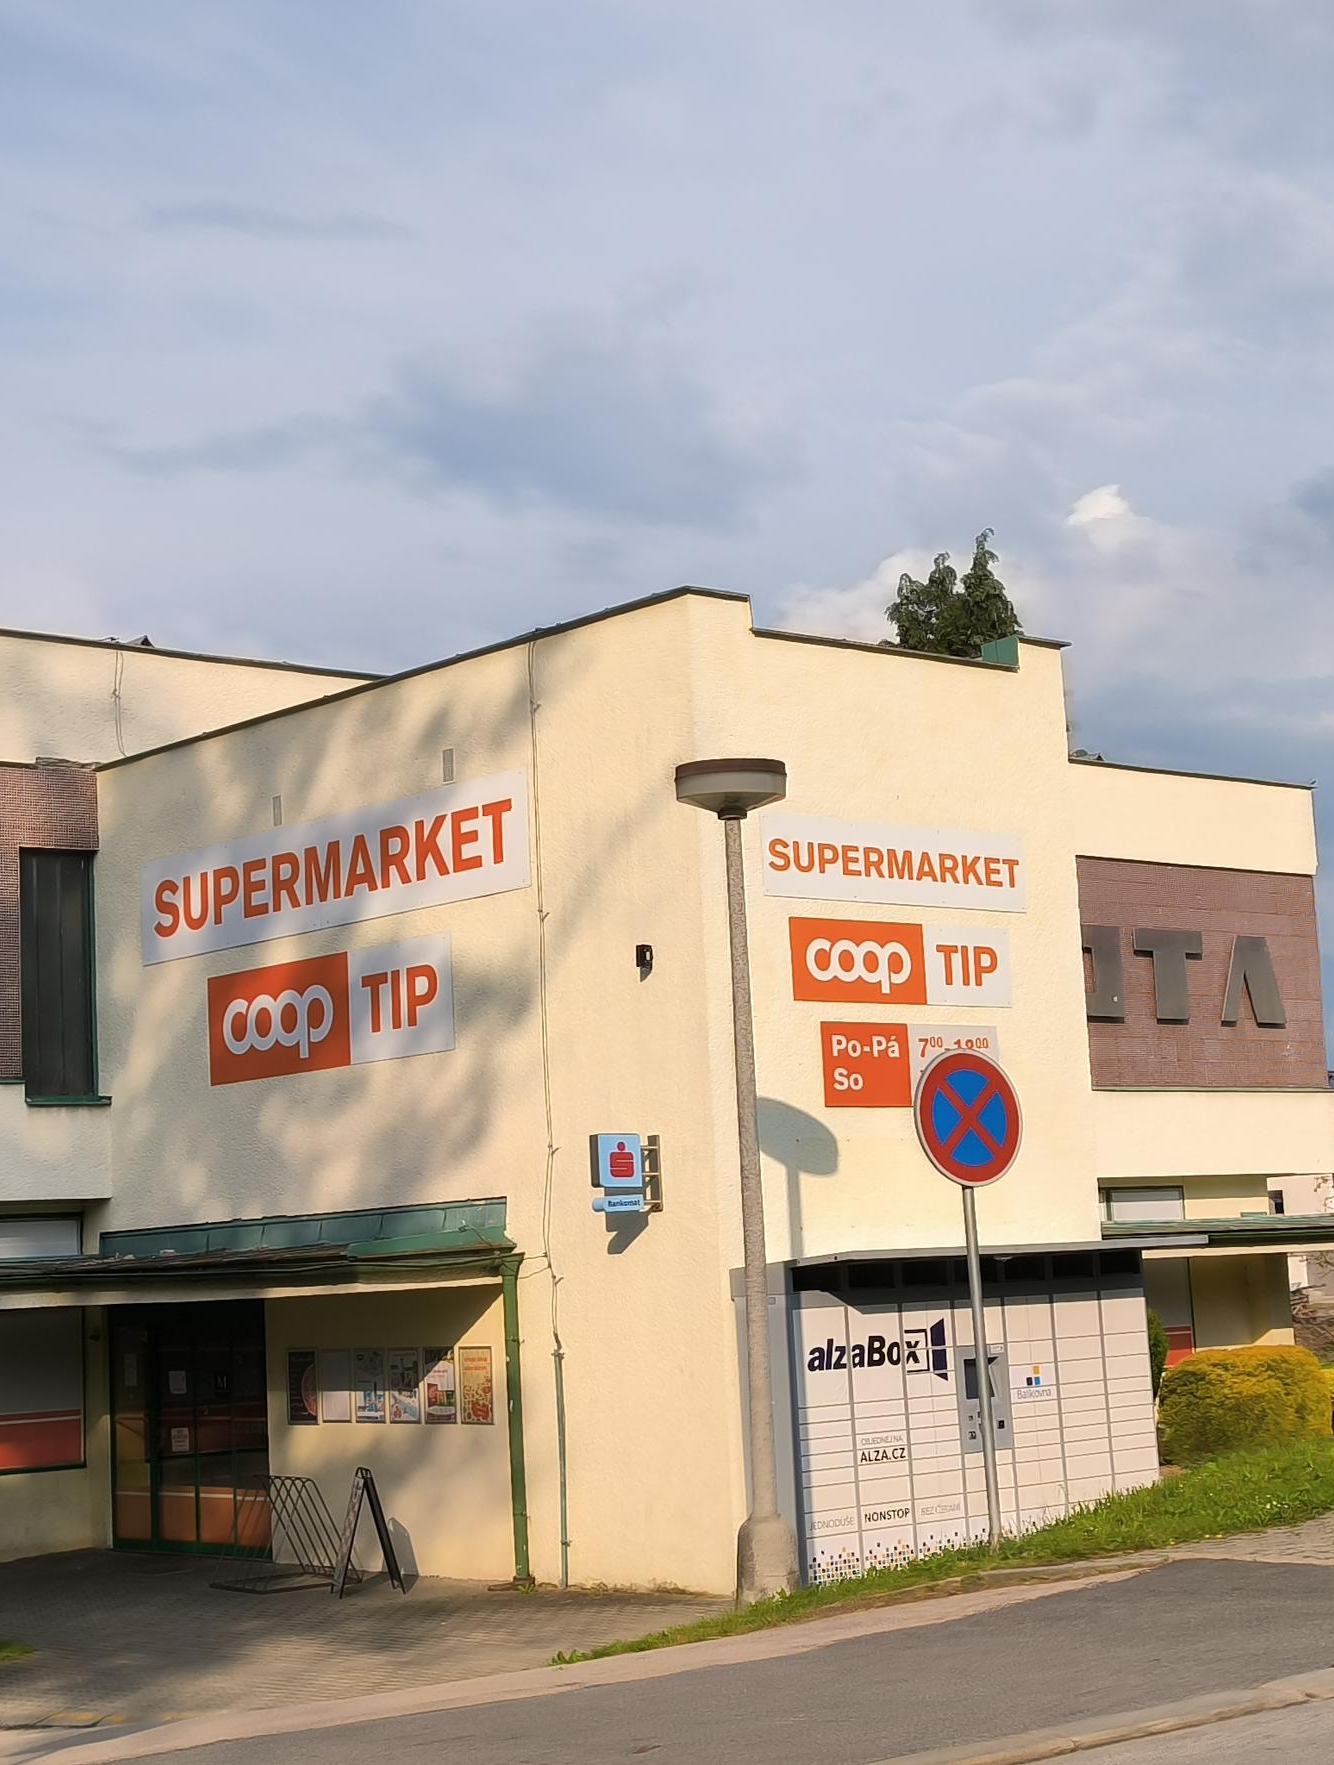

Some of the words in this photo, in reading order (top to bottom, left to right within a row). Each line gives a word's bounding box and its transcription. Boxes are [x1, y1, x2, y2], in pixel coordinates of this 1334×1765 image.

[153, 798, 513, 938] SUPERMARKET
[767, 838, 1020, 889] SUPERMARKET
[805, 937, 912, 994] coop
[935, 943, 998, 987] TIP
[222, 984, 335, 1059] coop
[361, 964, 438, 1034] TIP
[830, 1034, 900, 1059] Po-Pá
[832, 1067, 864, 1091] So
[607, 1198, 641, 1208] Bankomat
[807, 1335, 921, 1372] alzaBox
[860, 1447, 906, 1463] ALZA.CZ
[864, 1507, 910, 1523] NONSTOP
